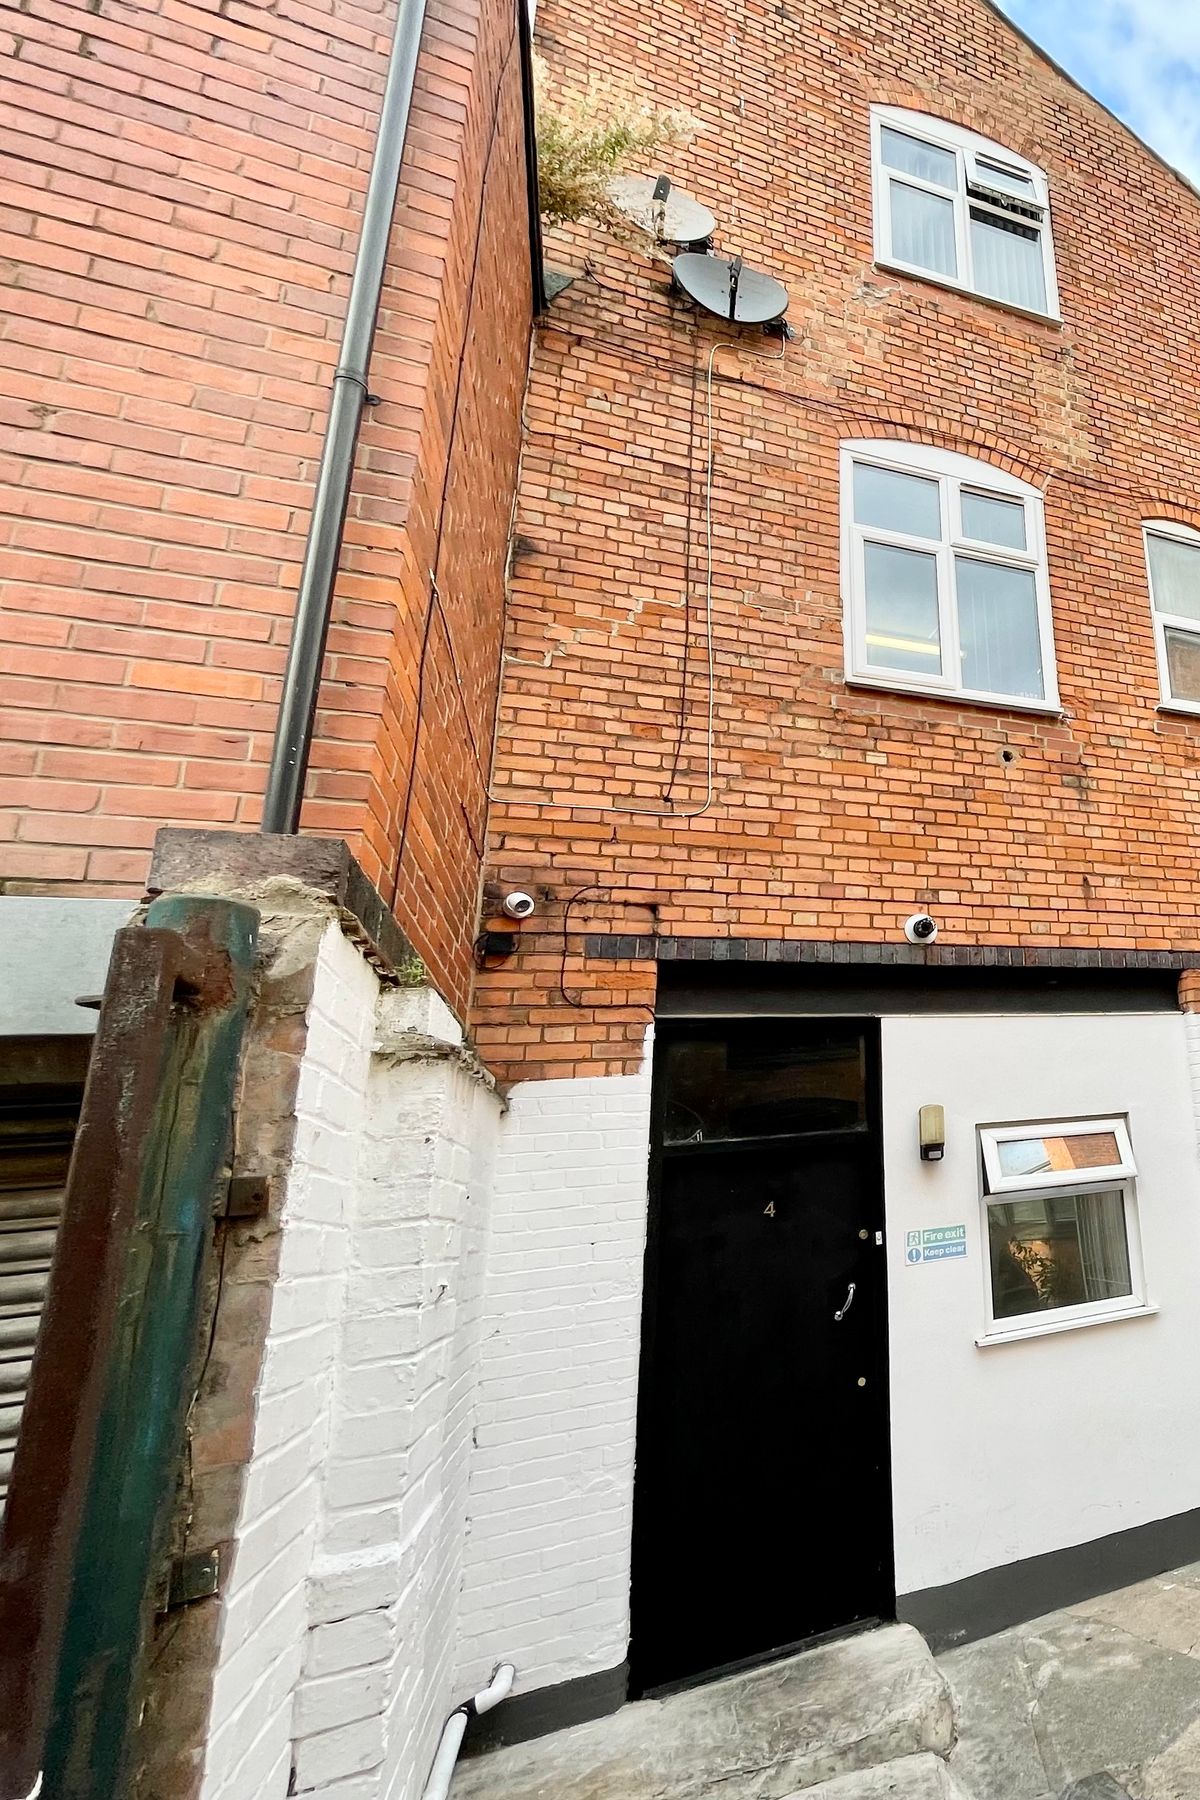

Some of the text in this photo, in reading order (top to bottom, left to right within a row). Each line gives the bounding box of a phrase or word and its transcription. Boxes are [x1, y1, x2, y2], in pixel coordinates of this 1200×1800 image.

[763, 1200, 776, 1218] 4
[924, 1227, 964, 1242] Fire exit
[924, 1245, 965, 1257] Keep clear
